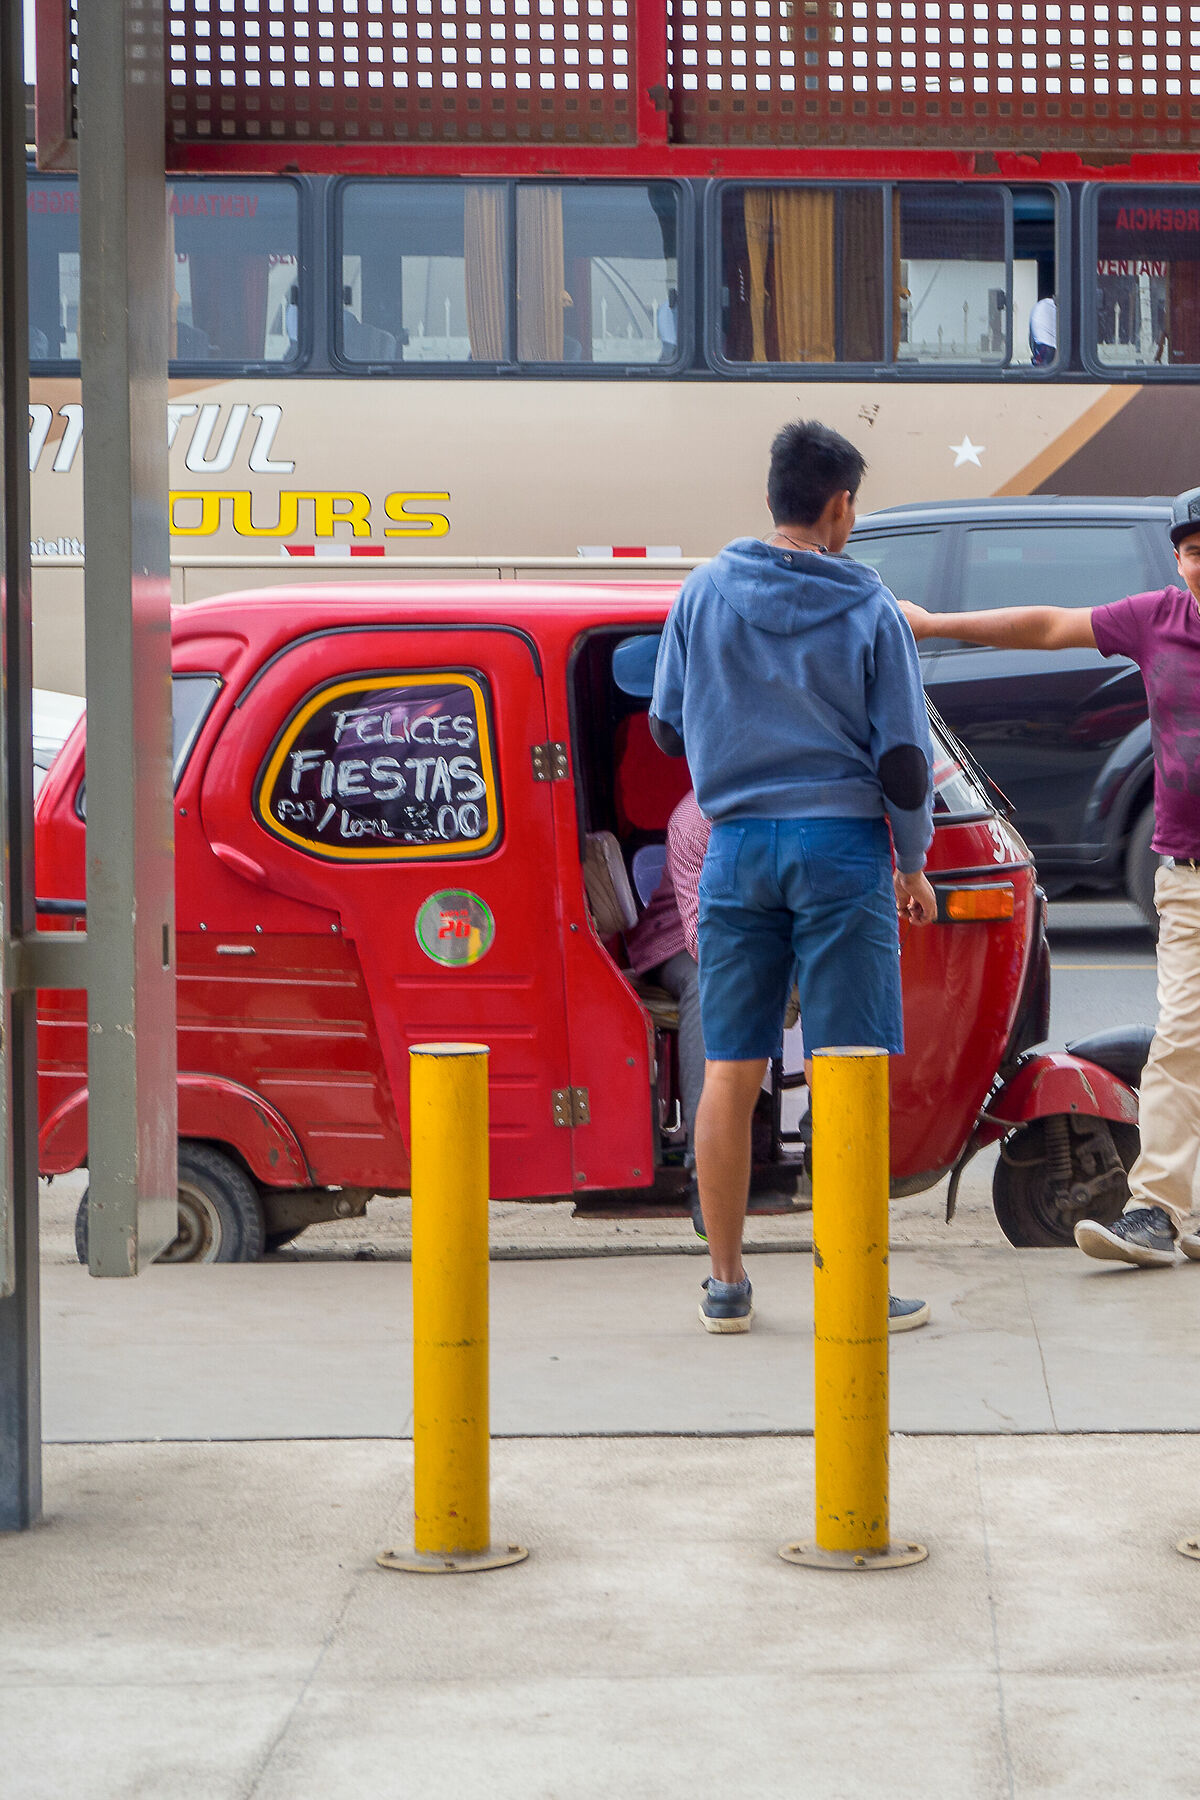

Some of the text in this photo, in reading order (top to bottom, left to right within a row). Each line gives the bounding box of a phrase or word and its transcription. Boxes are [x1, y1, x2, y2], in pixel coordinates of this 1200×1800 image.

[168, 490, 451, 538] OURS
[332, 708, 475, 748] FELICES
[289, 750, 486, 802] FIESTAS
